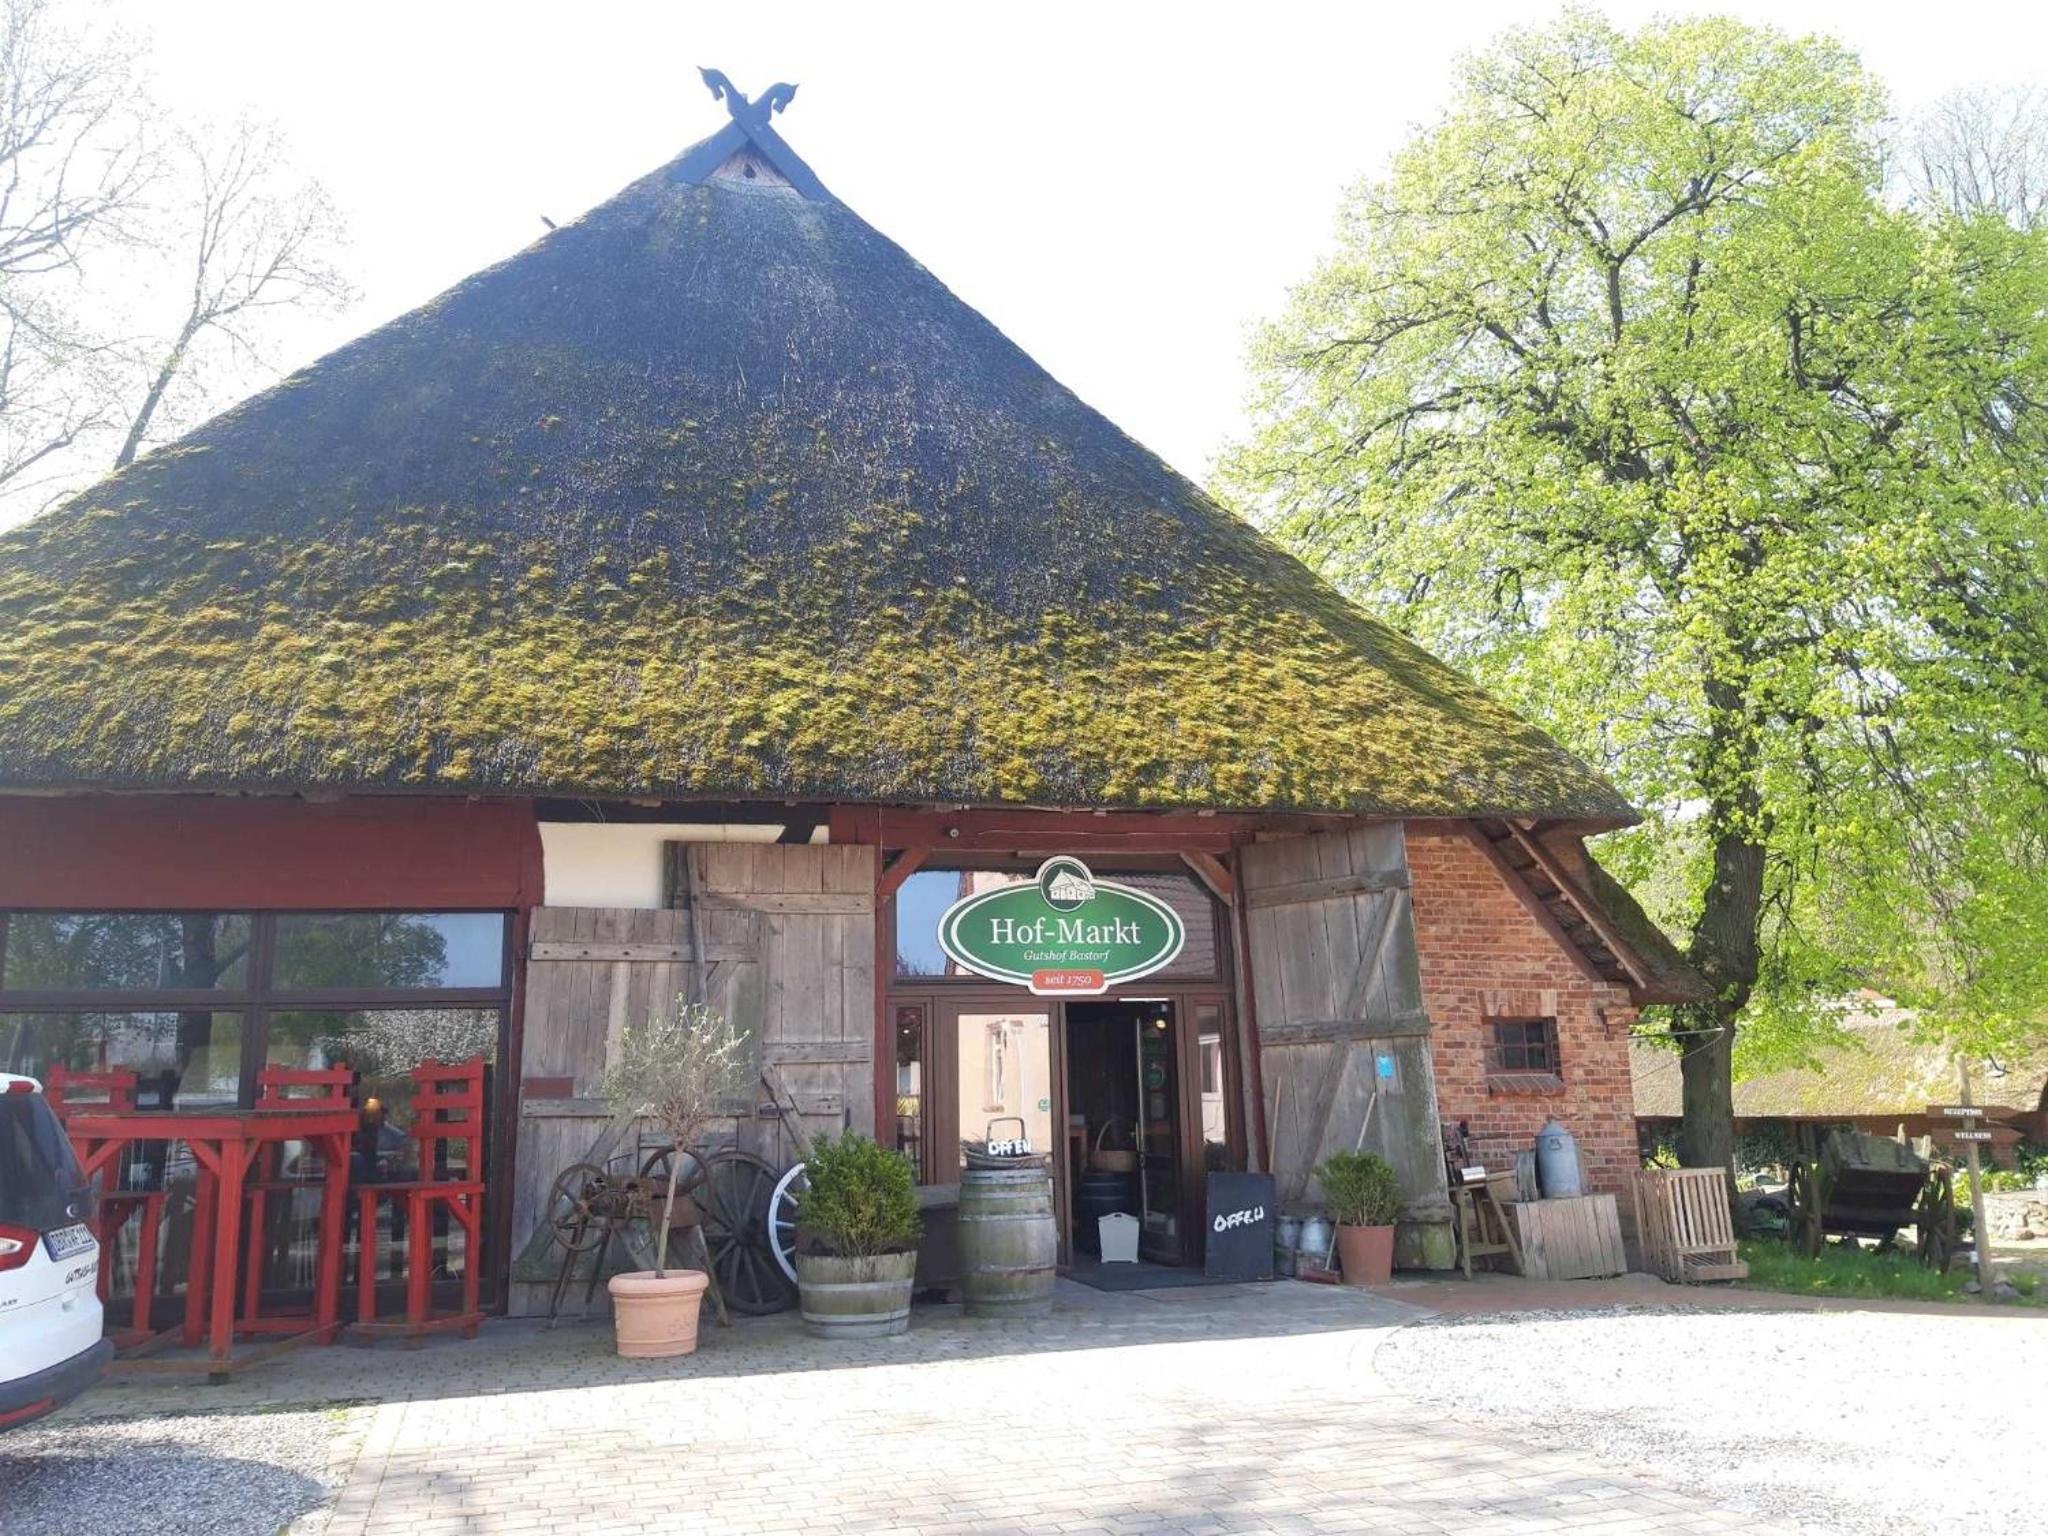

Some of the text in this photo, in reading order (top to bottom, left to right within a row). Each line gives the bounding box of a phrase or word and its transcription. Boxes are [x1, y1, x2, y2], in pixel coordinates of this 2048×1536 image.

[989, 916, 1142, 945] Hof-Markt
[1023, 949, 1110, 963] Gutshof Bastorf
[1044, 974, 1092, 986] seit 1750
[1954, 1131, 1992, 1140] WELLNESS
